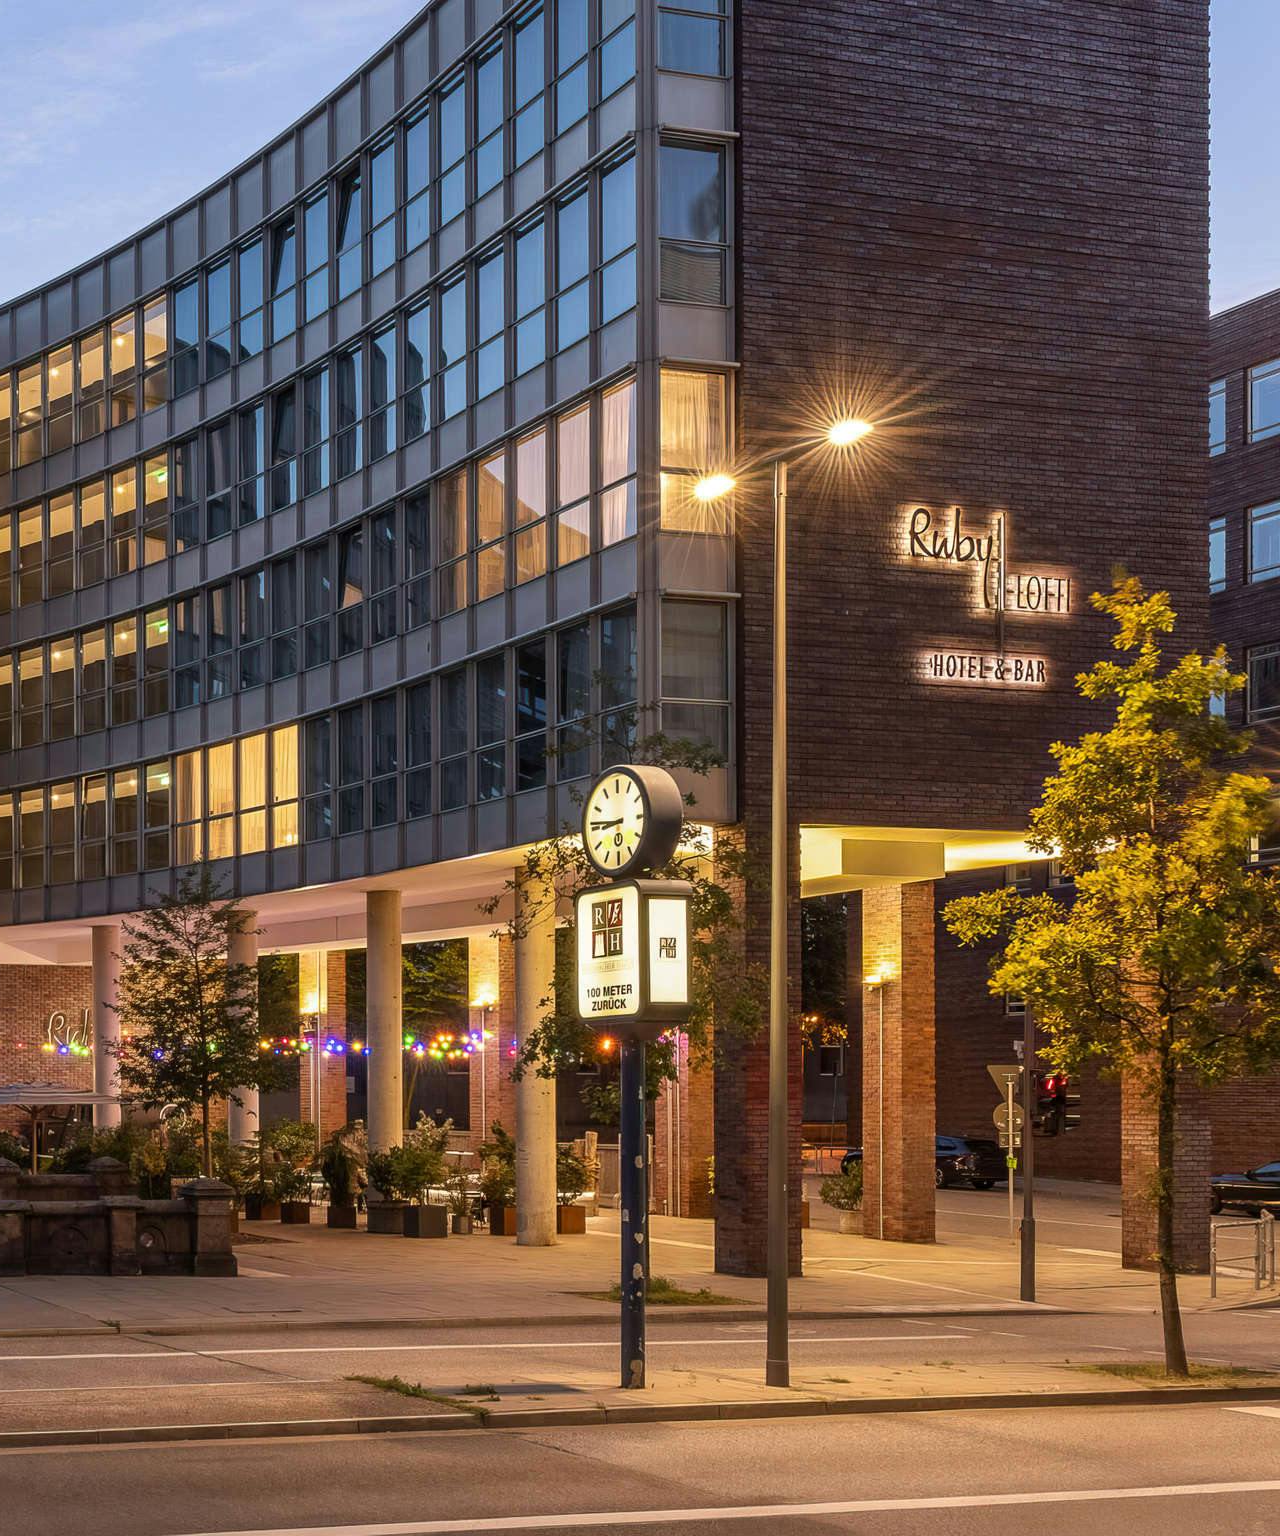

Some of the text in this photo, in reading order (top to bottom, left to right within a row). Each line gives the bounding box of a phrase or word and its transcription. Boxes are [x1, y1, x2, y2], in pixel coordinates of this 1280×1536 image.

[909, 508, 993, 608] Ruby
[932, 654, 1046, 682] HOTEL & BAR
[587, 984, 632, 998] 100 METER
[592, 997, 626, 1011] ZURÜCK
